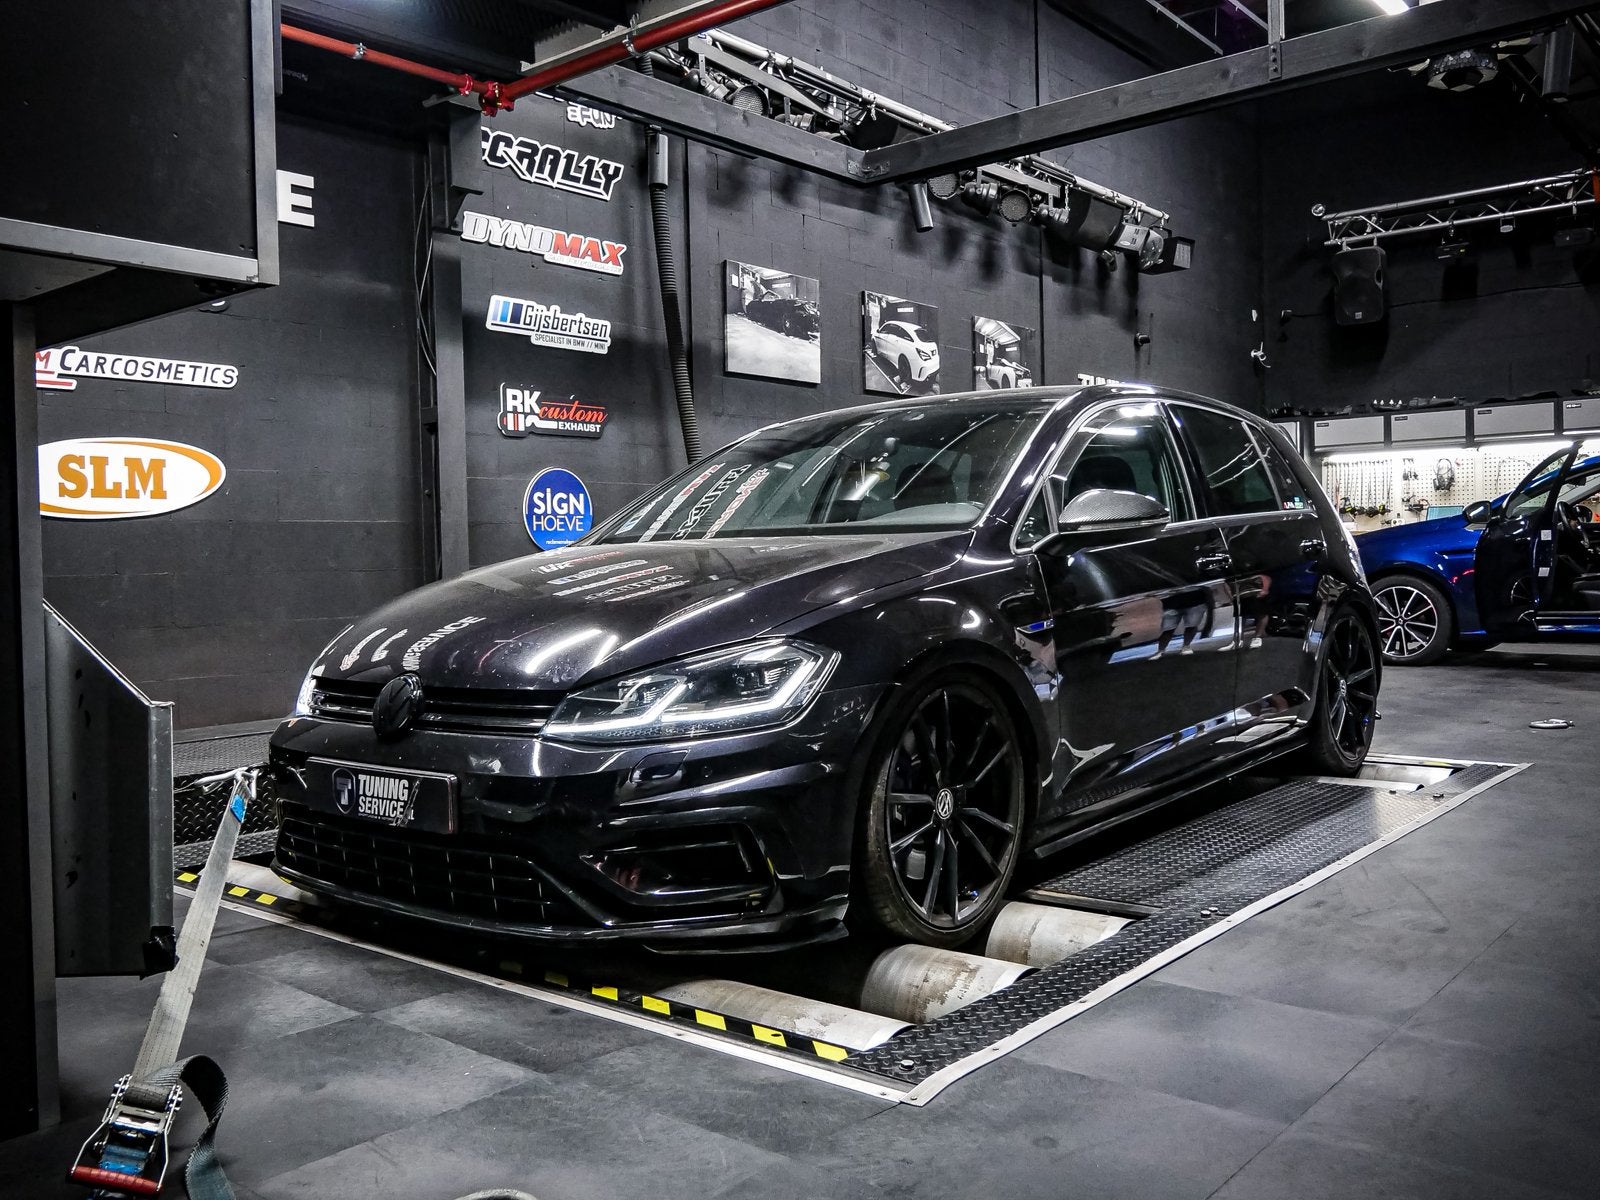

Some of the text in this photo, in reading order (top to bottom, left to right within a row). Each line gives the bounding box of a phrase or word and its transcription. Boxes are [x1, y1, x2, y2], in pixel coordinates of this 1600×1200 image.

[463, 212, 625, 267] DYNOMAX
[523, 305, 608, 338] Gijsbertsen
[534, 333, 565, 345] SPECIALIST
[573, 339, 585, 347] BMW
[59, 349, 236, 385] CARCOSMETICS
[505, 388, 541, 413] RK
[538, 399, 608, 423] custom
[558, 421, 602, 433] EXHAUST
[57, 453, 168, 500] SLM
[533, 515, 584, 532] HOEVE
[358, 774, 409, 802] TUNING
[358, 795, 405, 818] SERVICE
